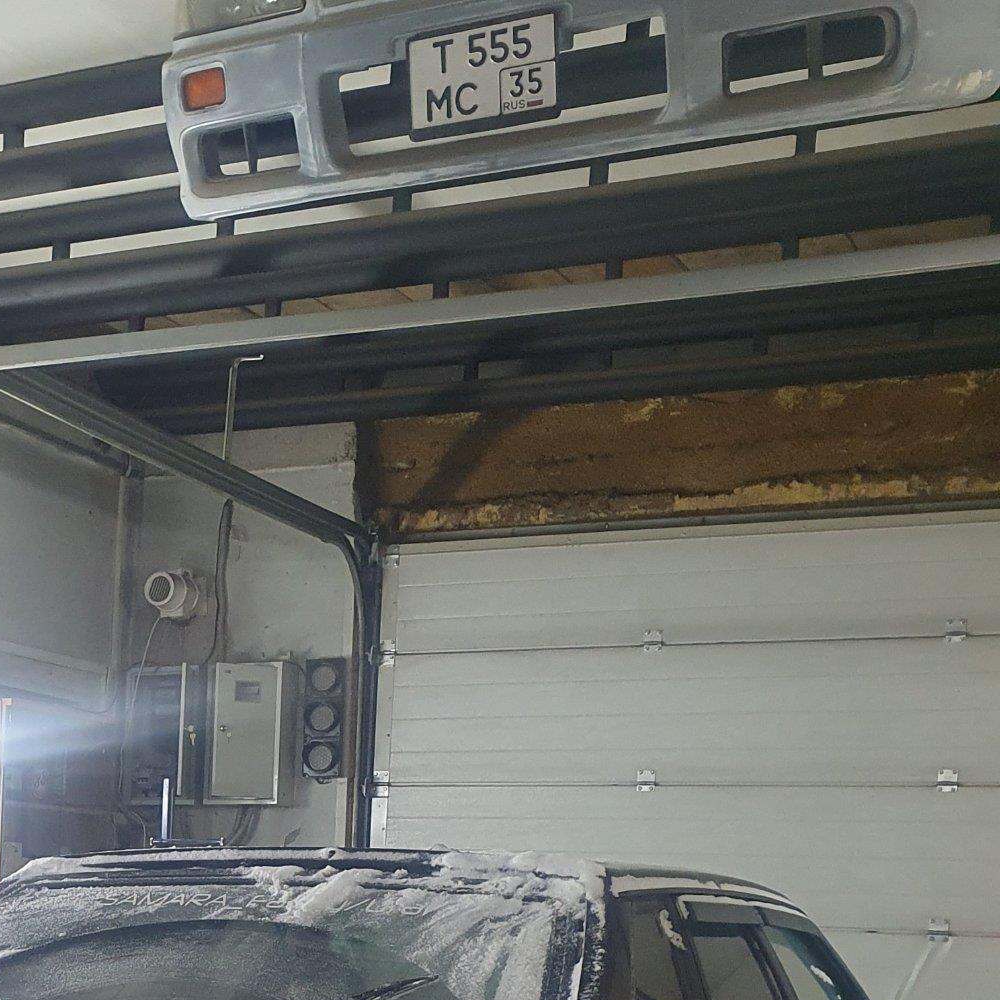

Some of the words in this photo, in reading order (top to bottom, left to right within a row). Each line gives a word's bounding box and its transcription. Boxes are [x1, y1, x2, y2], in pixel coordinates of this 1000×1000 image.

[432, 39, 454, 74] Т
[467, 23, 532, 68] 555
[509, 67, 543, 98] 35
[426, 82, 479, 123] МС
[503, 100, 526, 112] RUS
